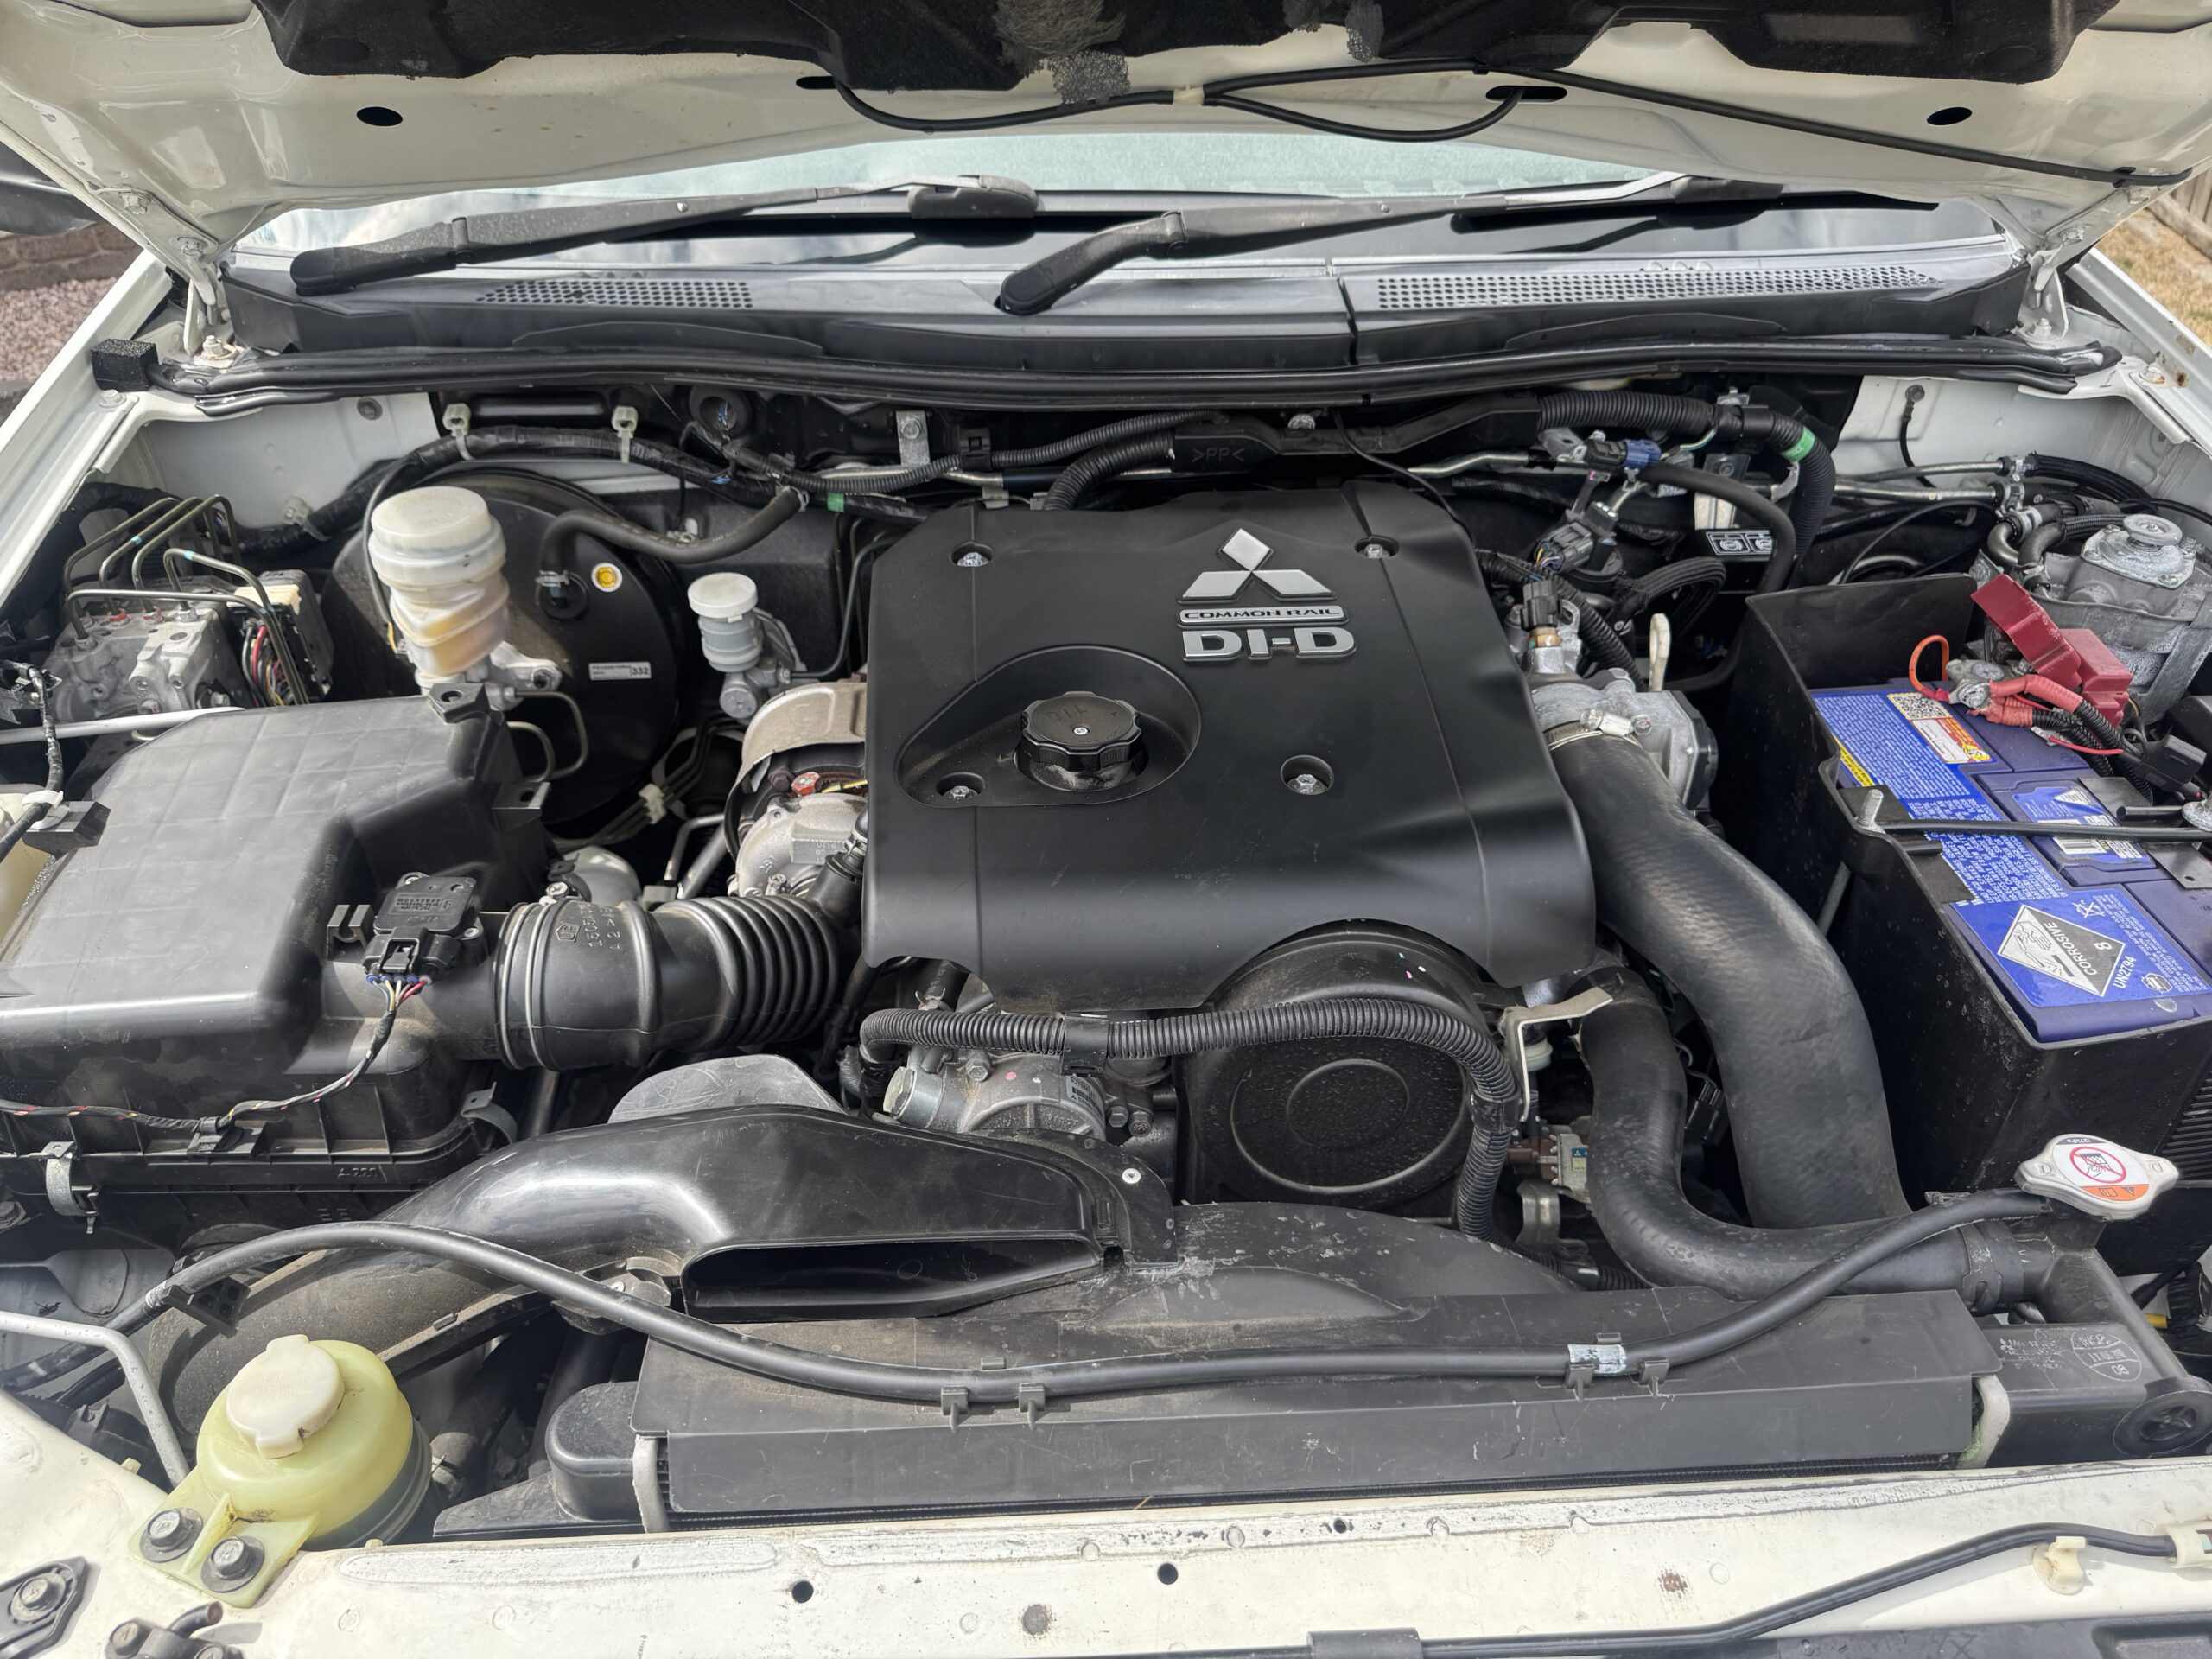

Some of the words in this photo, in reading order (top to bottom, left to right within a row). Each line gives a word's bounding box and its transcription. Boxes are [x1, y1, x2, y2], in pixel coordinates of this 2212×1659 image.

[1185, 610, 1281, 620] COMMON
[1287, 608, 1340, 617] RAIL
[1182, 627, 1355, 658] DI-D
[2044, 921, 2097, 976] CORROSIVE
[2094, 940, 2113, 952] 8
[2113, 955, 2137, 989] UN2794
